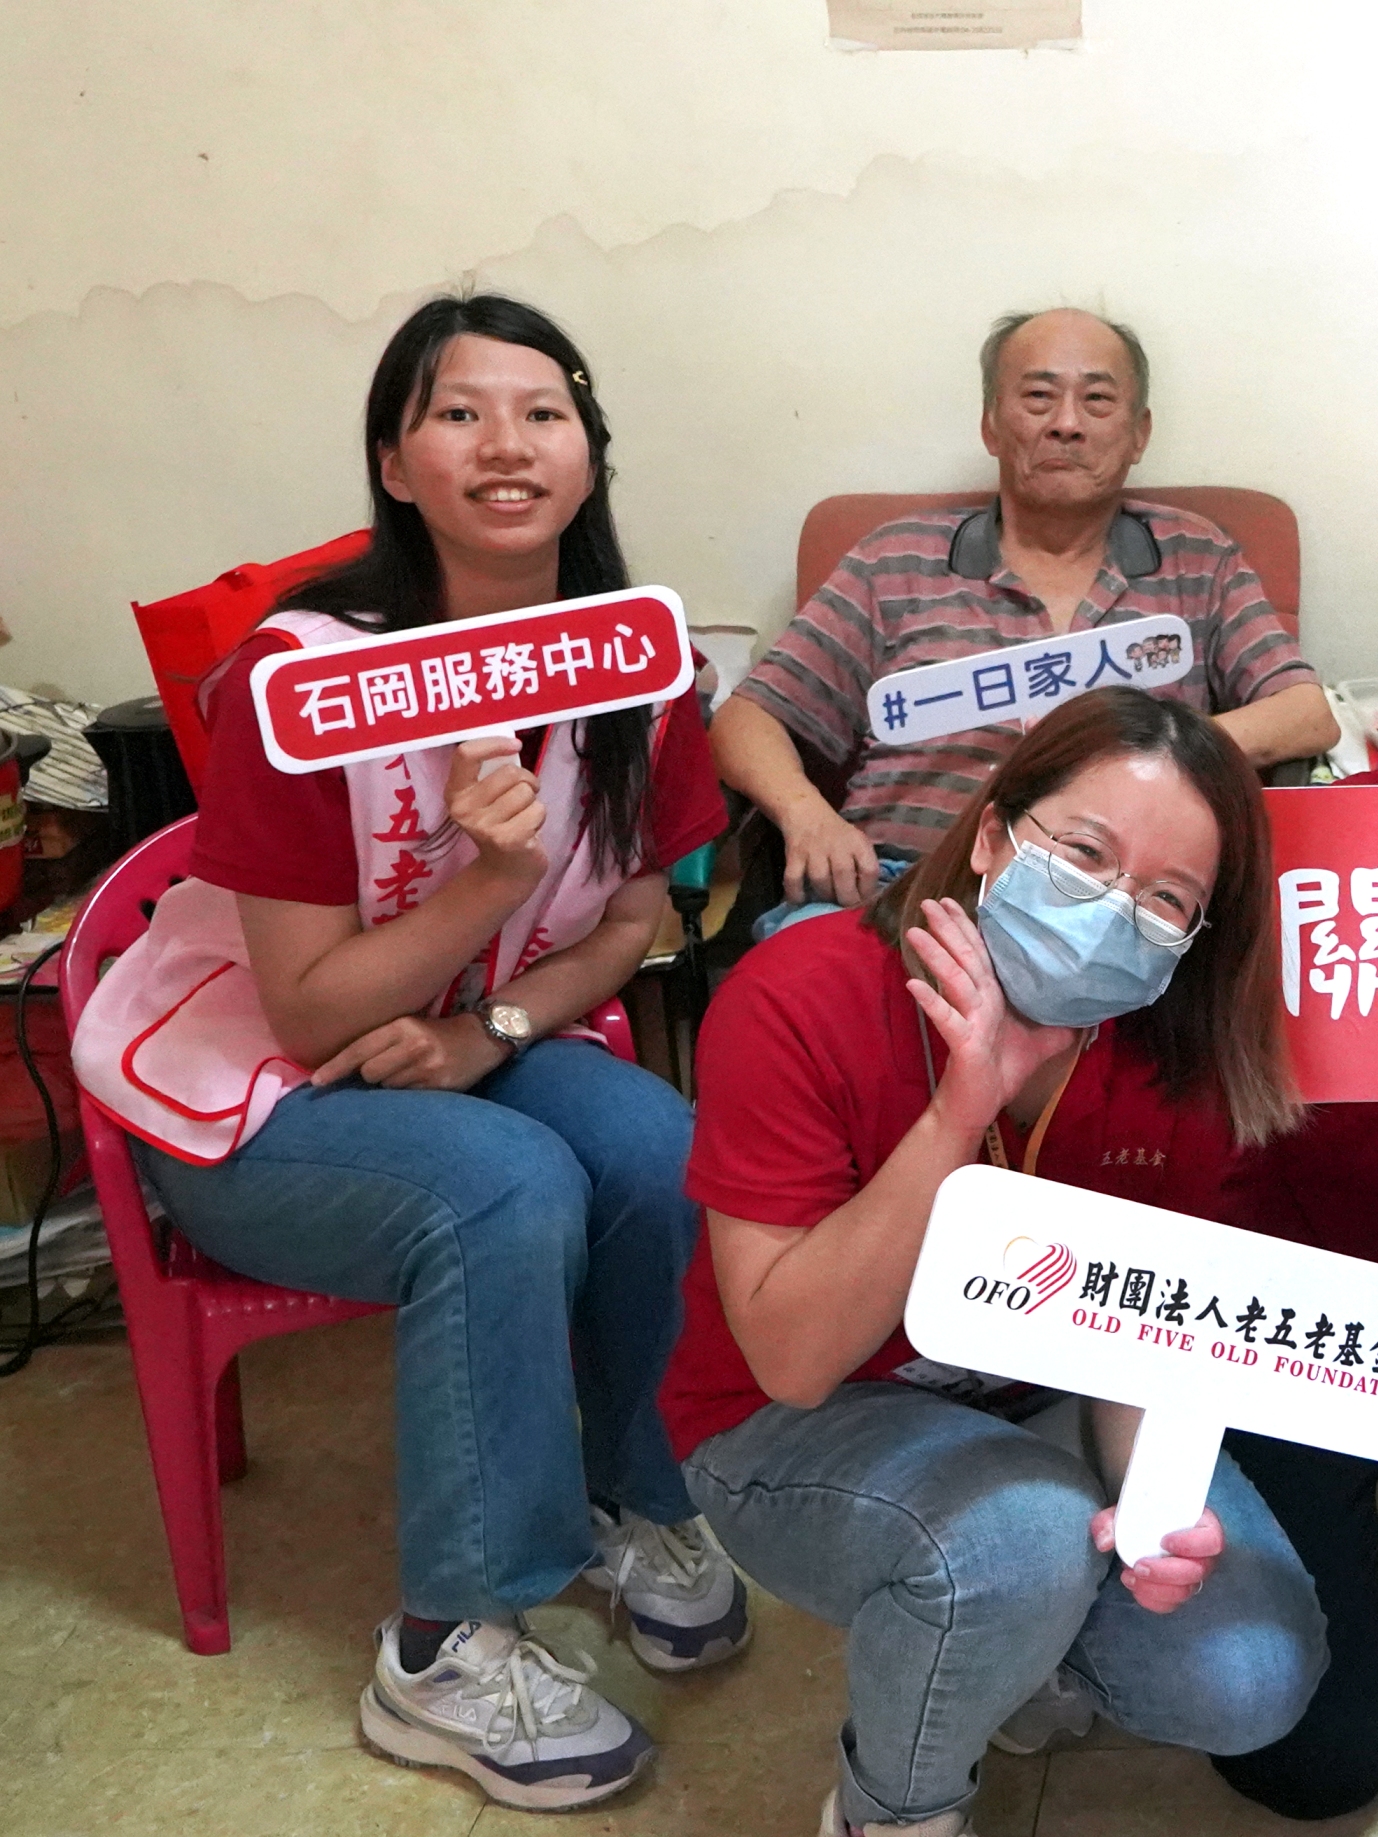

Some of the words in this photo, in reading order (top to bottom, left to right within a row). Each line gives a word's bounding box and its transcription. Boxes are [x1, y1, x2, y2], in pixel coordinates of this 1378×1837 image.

[294, 623, 656, 736] 石岡服務中心
[962, 1275, 1031, 1312] OFO
[1072, 1308, 1121, 1335] OLD
[1138, 1323, 1196, 1353] FIVE
[1211, 1340, 1259, 1368] OLD
